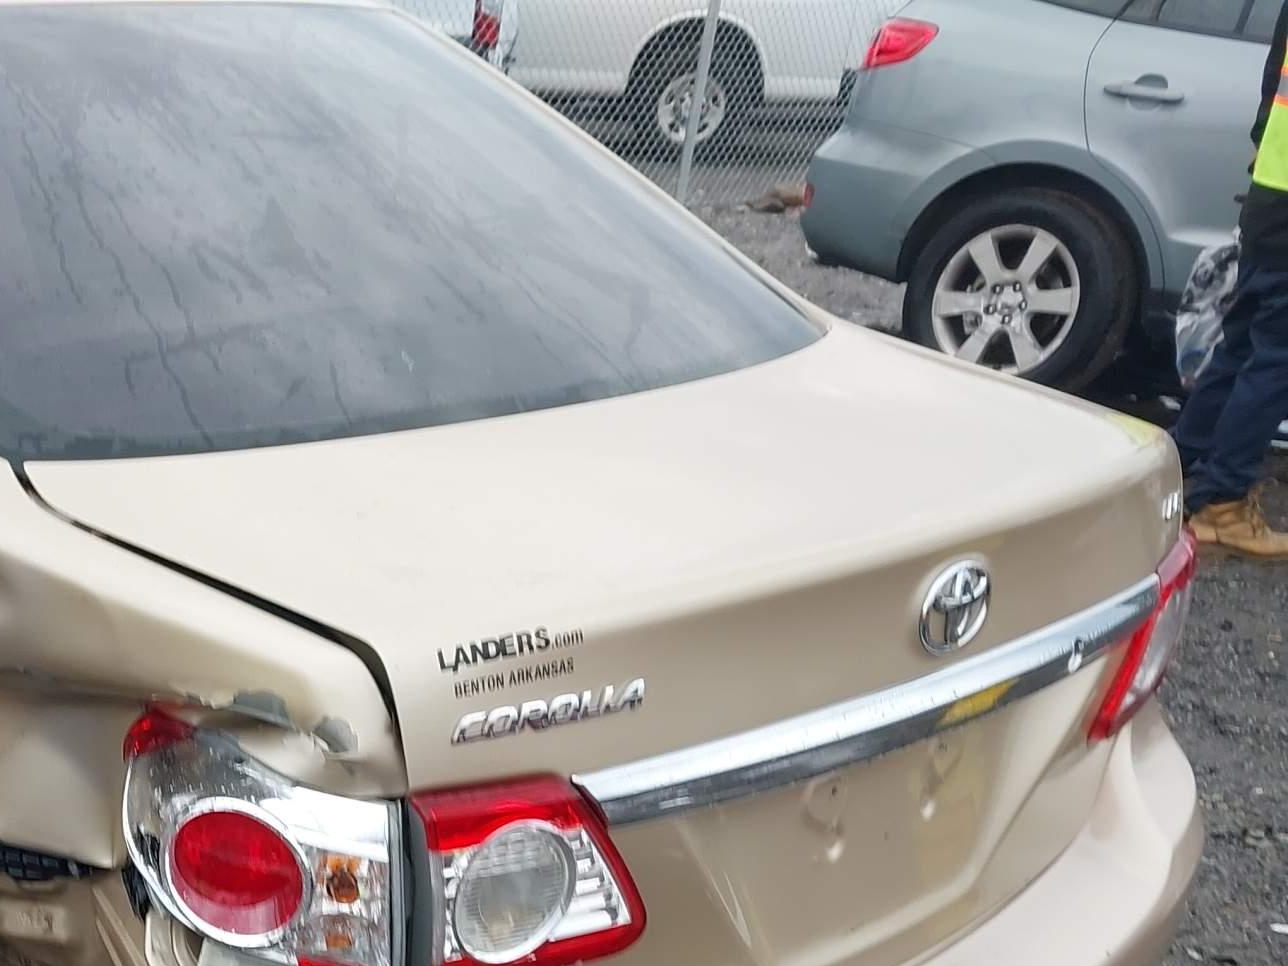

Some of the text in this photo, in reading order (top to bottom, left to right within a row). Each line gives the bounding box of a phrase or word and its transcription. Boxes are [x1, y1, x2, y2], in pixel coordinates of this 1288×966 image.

[437, 626, 584, 672] LANDERS.com
[454, 656, 575, 698] BENTON ARKANSAS
[450, 677, 646, 745] COROLLA
